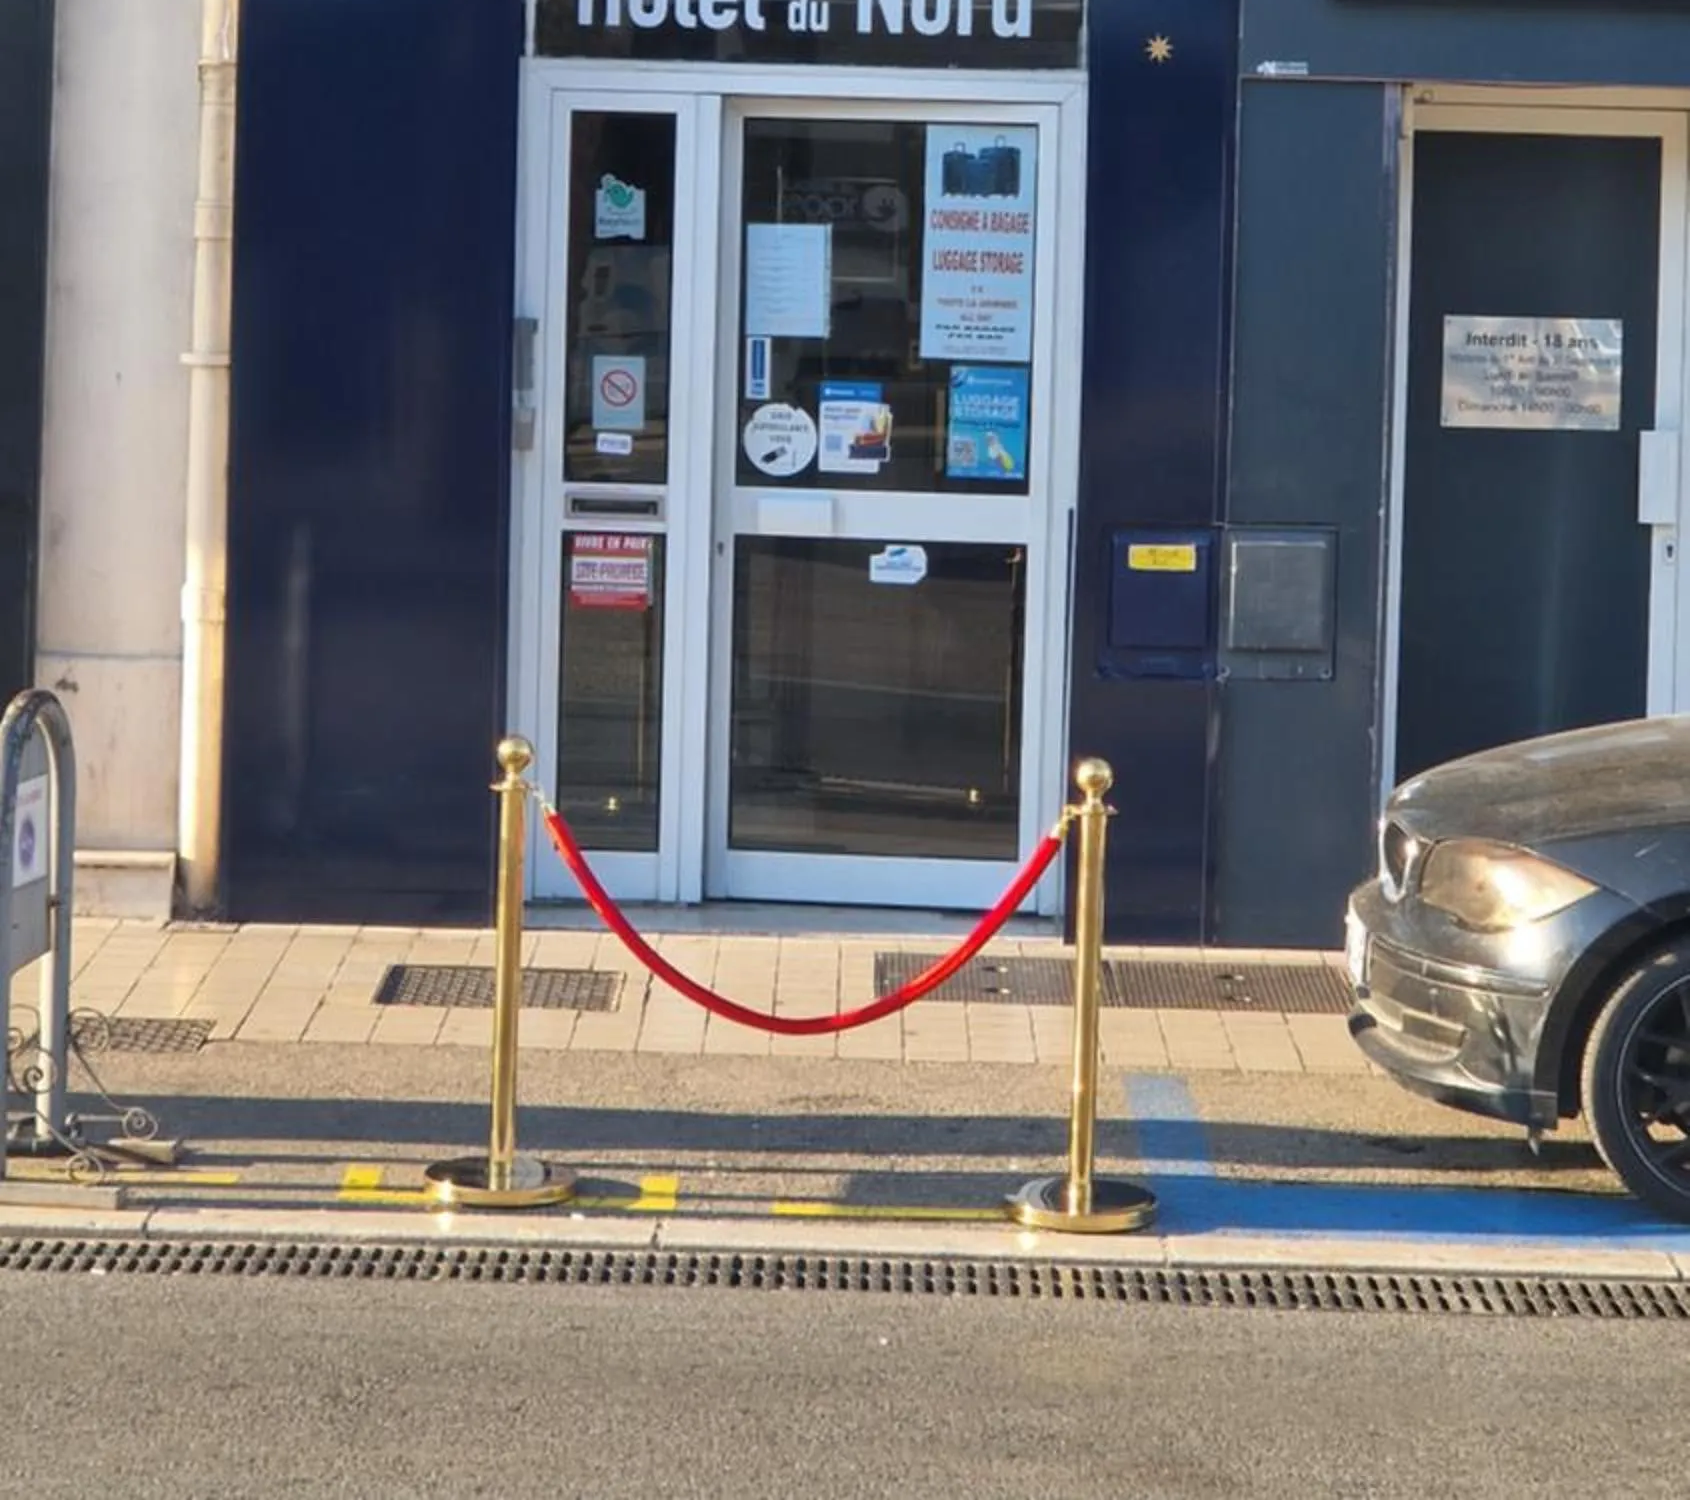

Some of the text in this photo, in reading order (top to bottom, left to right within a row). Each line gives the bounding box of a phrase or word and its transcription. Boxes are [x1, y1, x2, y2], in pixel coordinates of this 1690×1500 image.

[930, 208, 979, 231] CONSIGNE
[991, 211, 1029, 234] BAGAGE
[932, 248, 1024, 275] LUGGAGE STORAGE
[1466, 332, 1527, 348] Interdit
[1544, 333, 1563, 347] 18
[1567, 338, 1598, 350] ans
